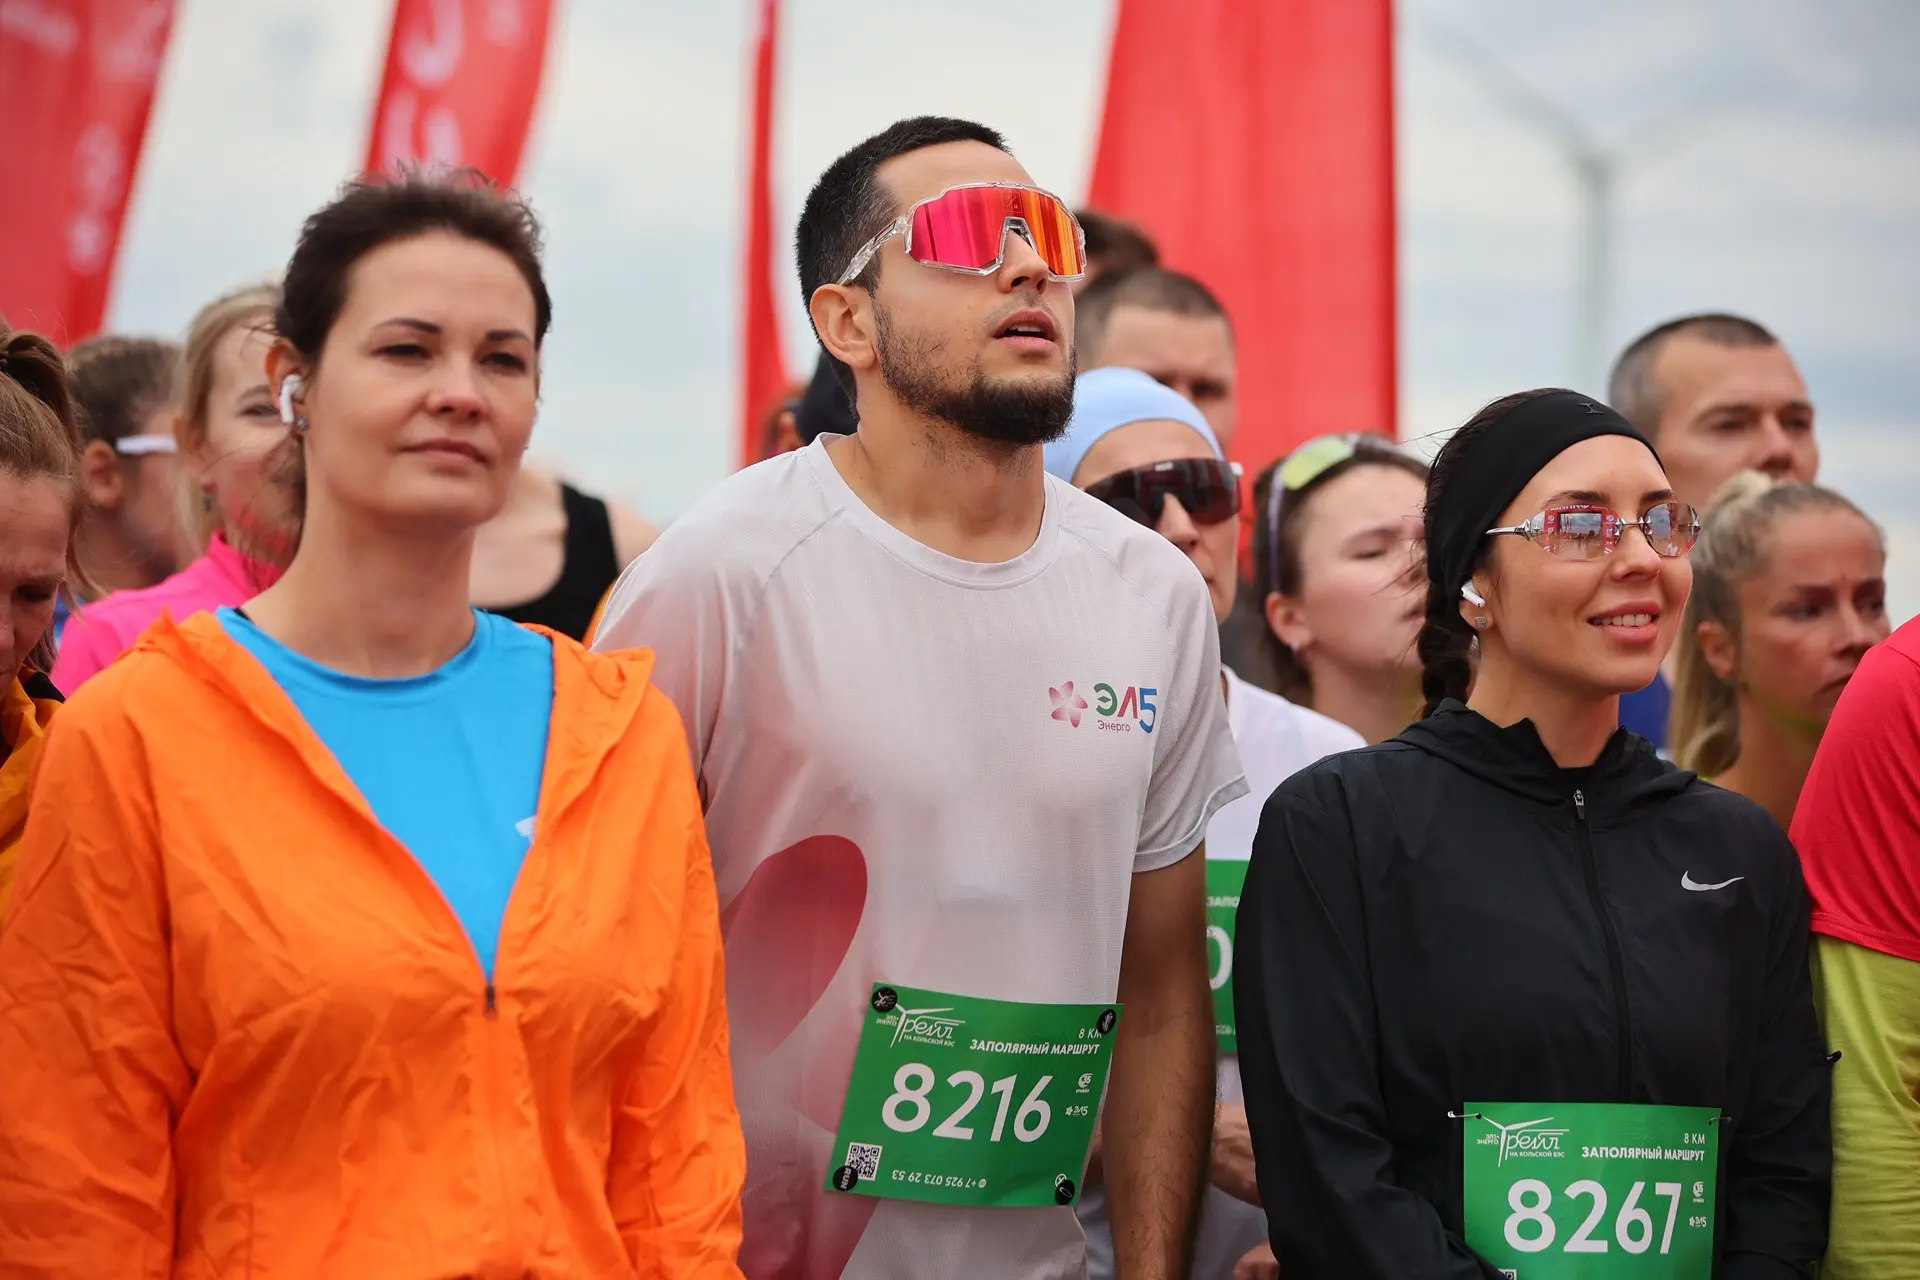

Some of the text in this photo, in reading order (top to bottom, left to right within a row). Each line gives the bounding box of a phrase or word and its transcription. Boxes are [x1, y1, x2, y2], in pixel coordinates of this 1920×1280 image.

[1093, 682, 1158, 733] ЭЛ5
[1097, 720, 1131, 732] Энерго
[1078, 1028, 1086, 1039] 8
[970, 1039, 1100, 1055] ЗАПОЛЯРНЫЙ МАРШРУТ
[881, 1062, 1054, 1143] 8216
[1684, 1132, 1705, 1145] 8 КМ
[1581, 1146, 1705, 1161] ЗАПОЛЯРНЫЙ МАРШРУТ
[840, 1167, 852, 1190] RUN
[892, 1169, 906, 1181] 53
[908, 1172, 922, 1183] 29
[924, 1174, 943, 1185] 073
[946, 1176, 963, 1187] 925
[1503, 1178, 1682, 1255] 8267
